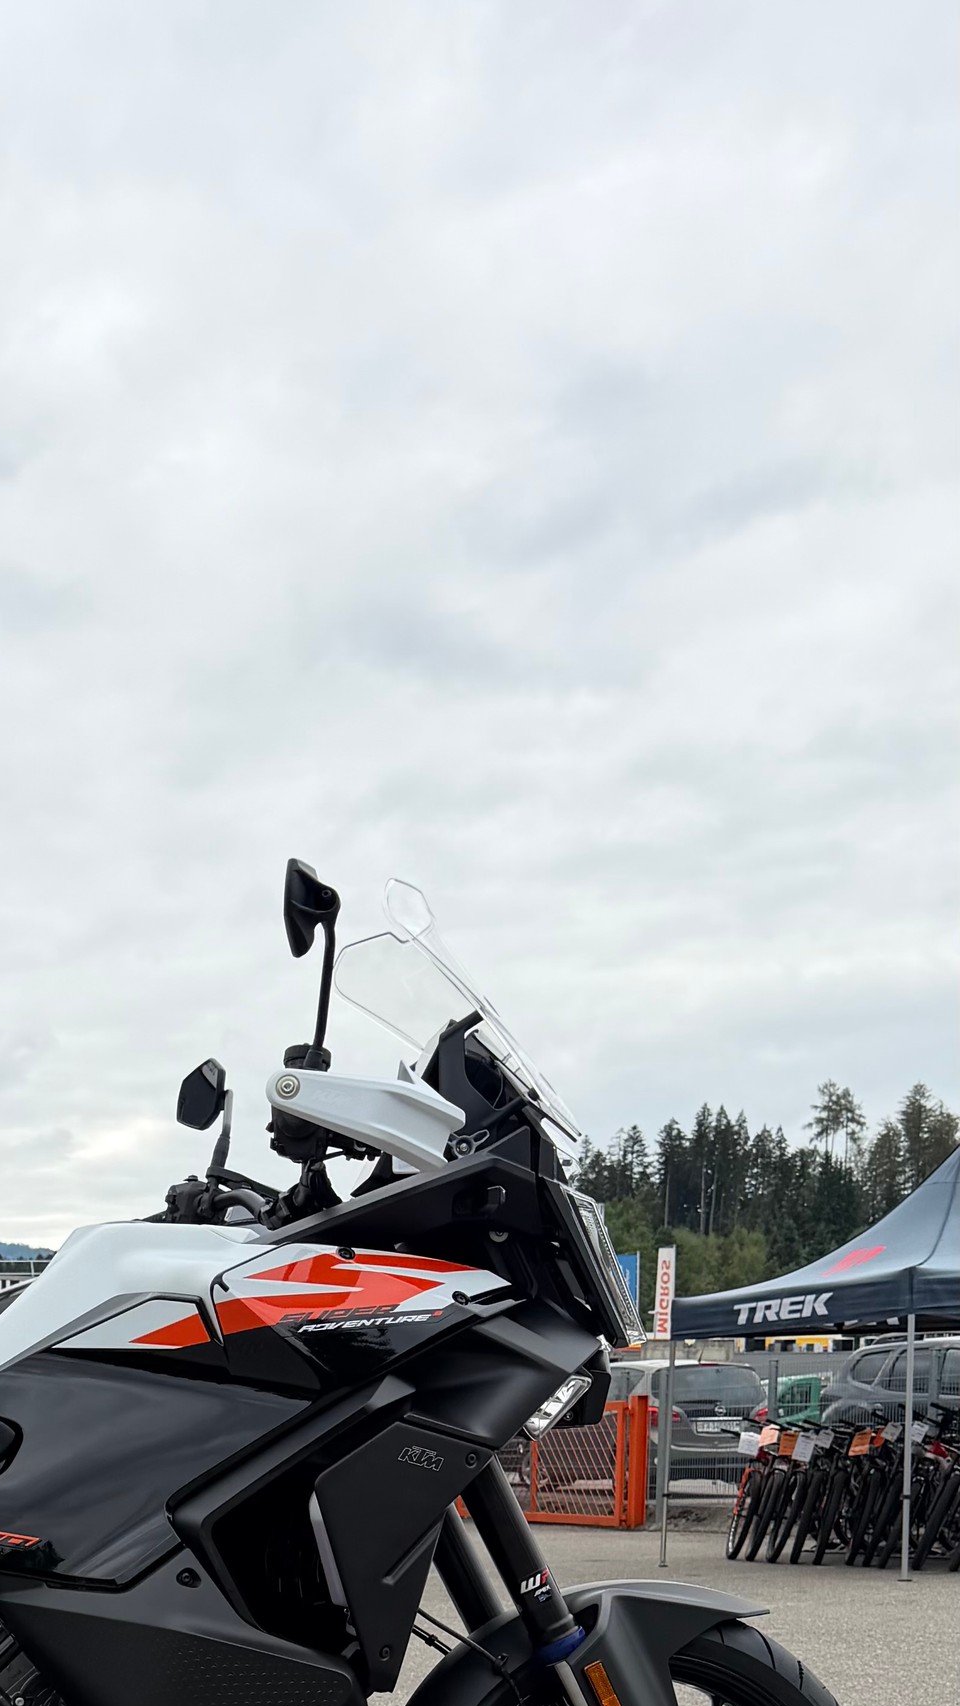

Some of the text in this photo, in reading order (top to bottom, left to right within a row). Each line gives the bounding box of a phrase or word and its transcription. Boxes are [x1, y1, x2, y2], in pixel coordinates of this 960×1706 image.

[279, 1304, 401, 1323] SUPER
[733, 1292, 833, 1325] TREK
[297, 1313, 432, 1333] ADVENTURE
[397, 1445, 445, 1472] KTM
